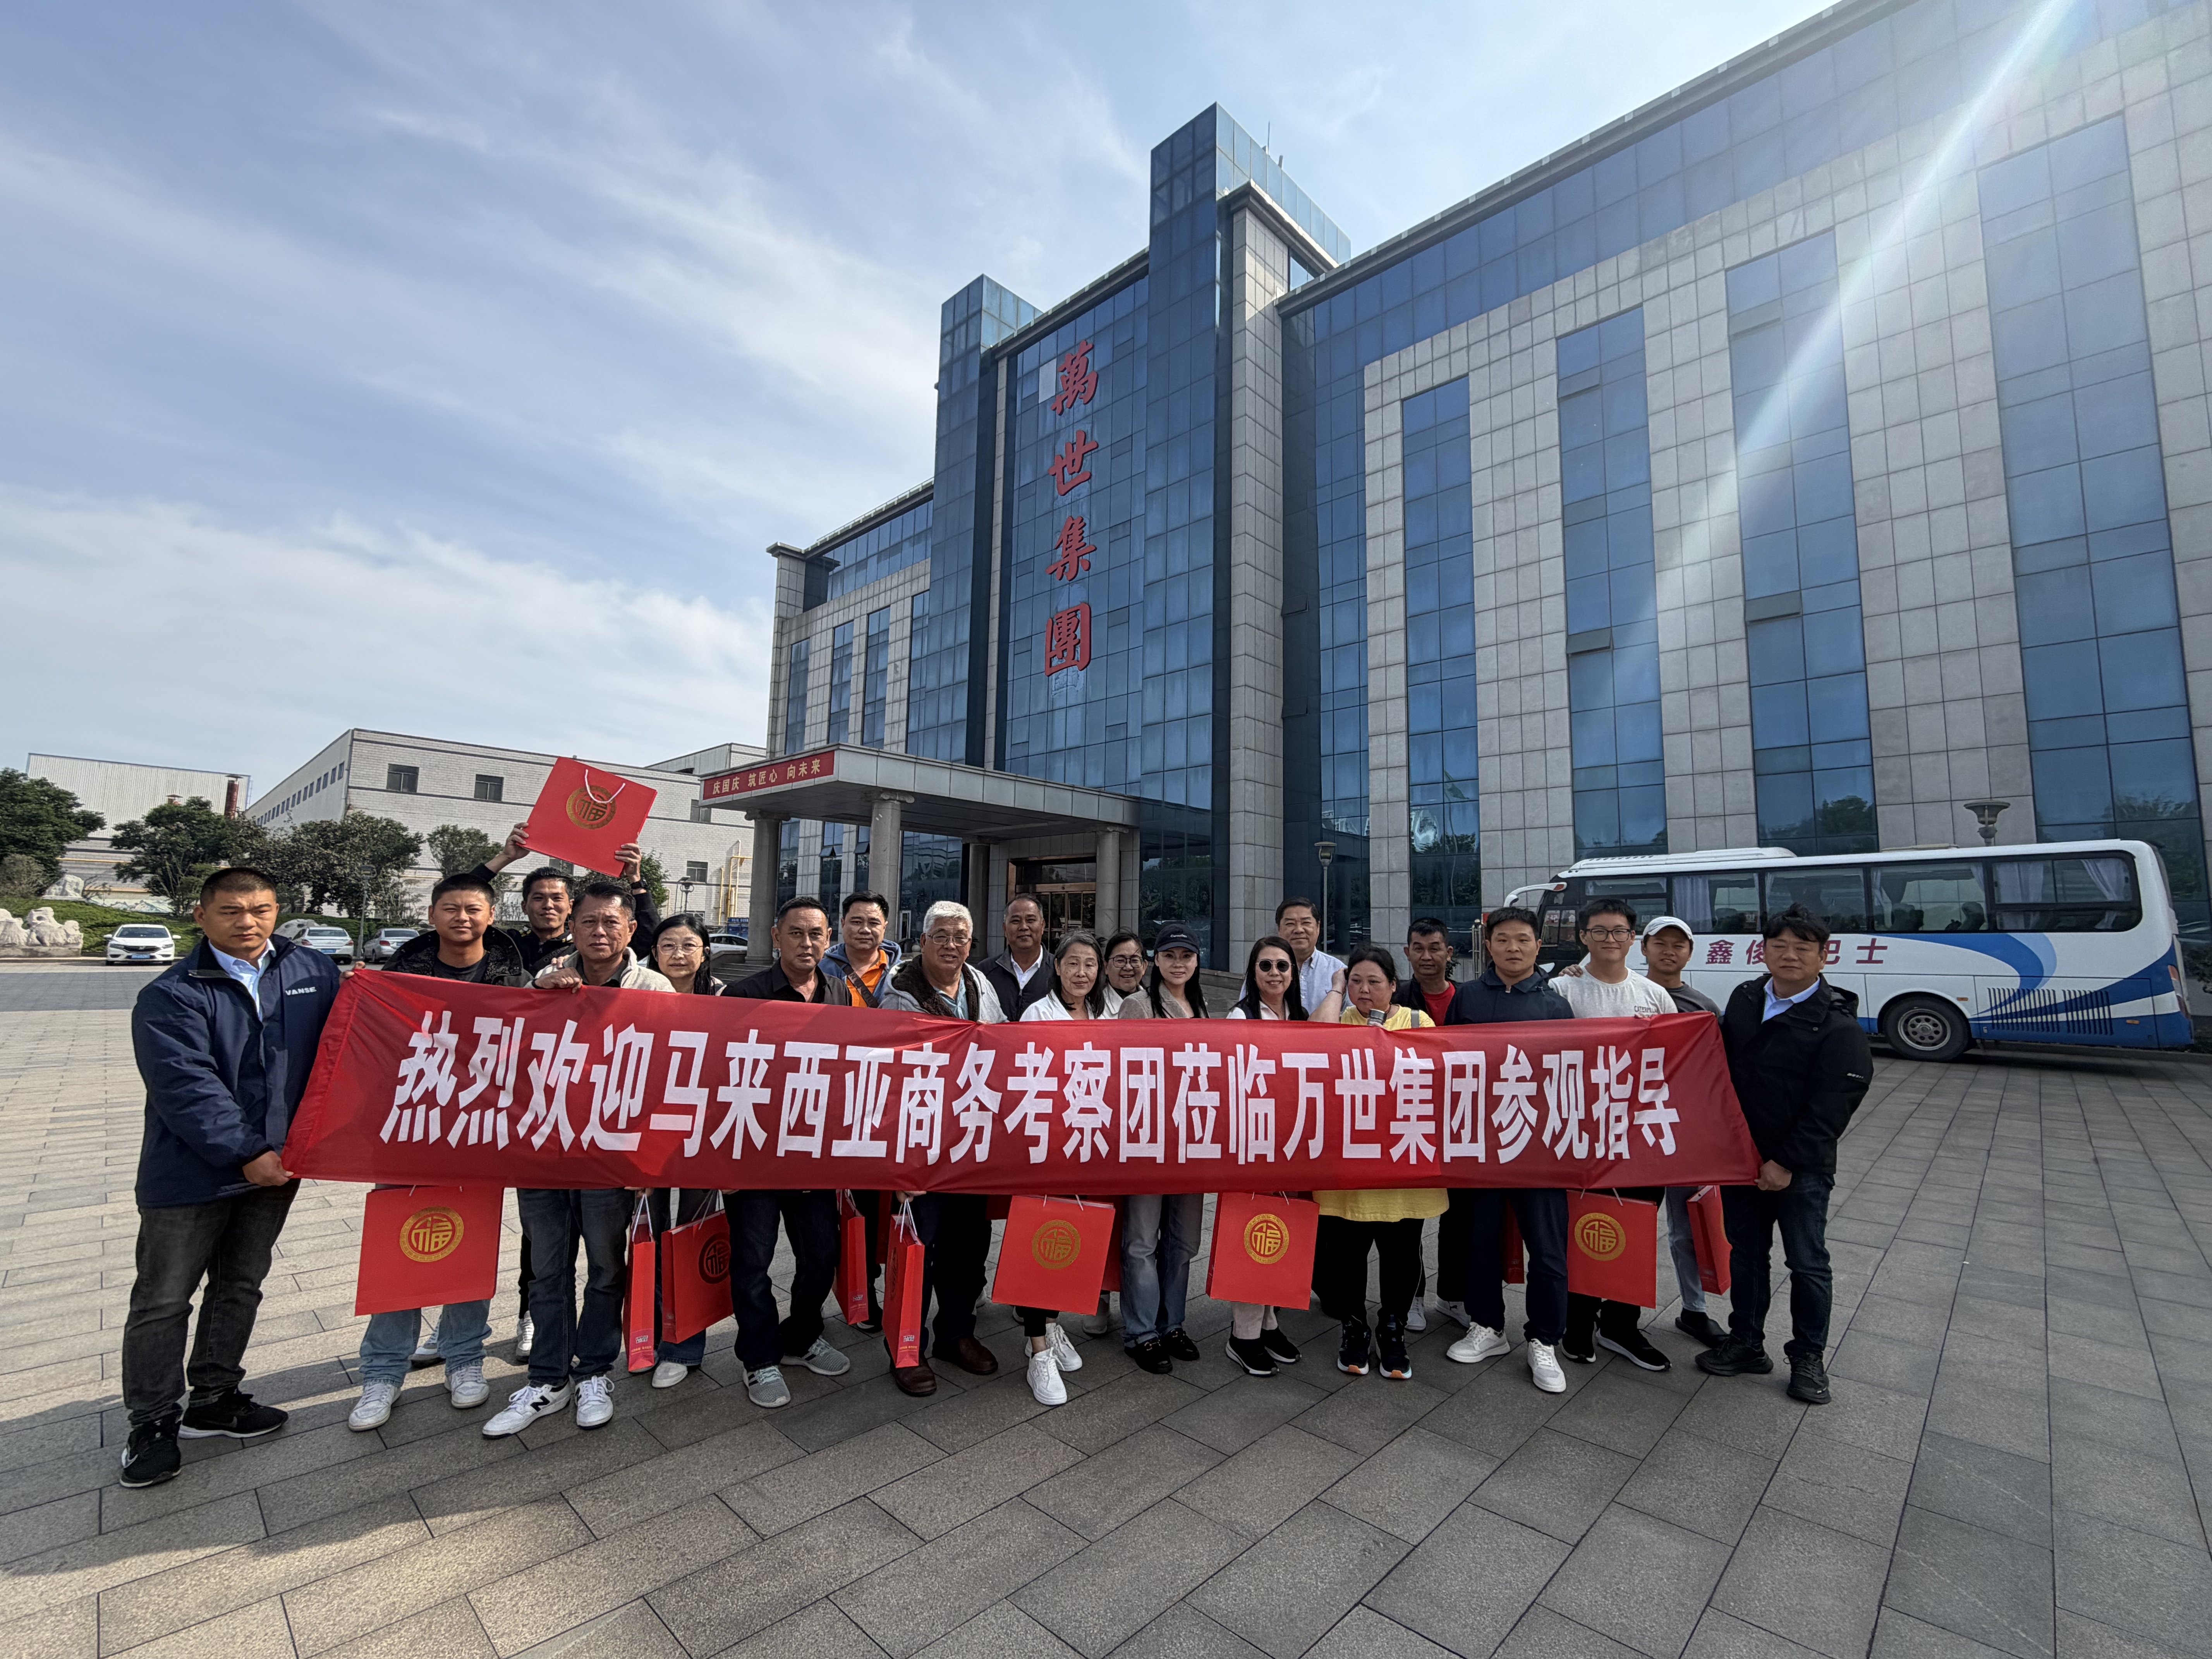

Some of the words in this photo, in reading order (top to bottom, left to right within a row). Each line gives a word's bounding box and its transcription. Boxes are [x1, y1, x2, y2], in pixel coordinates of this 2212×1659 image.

[1044, 340, 1098, 677] 萬世集團
[713, 776, 740, 795] 庆国庆
[748, 769, 778, 788] 筑匠心
[787, 758, 821, 780] 向未来
[1705, 938, 1888, 965] 鑫俊巴士
[285, 986, 317, 996] VANSE
[380, 1010, 1680, 1165] 热烈欢迎马来西亚商务考察团莅临万世集团参观指导
